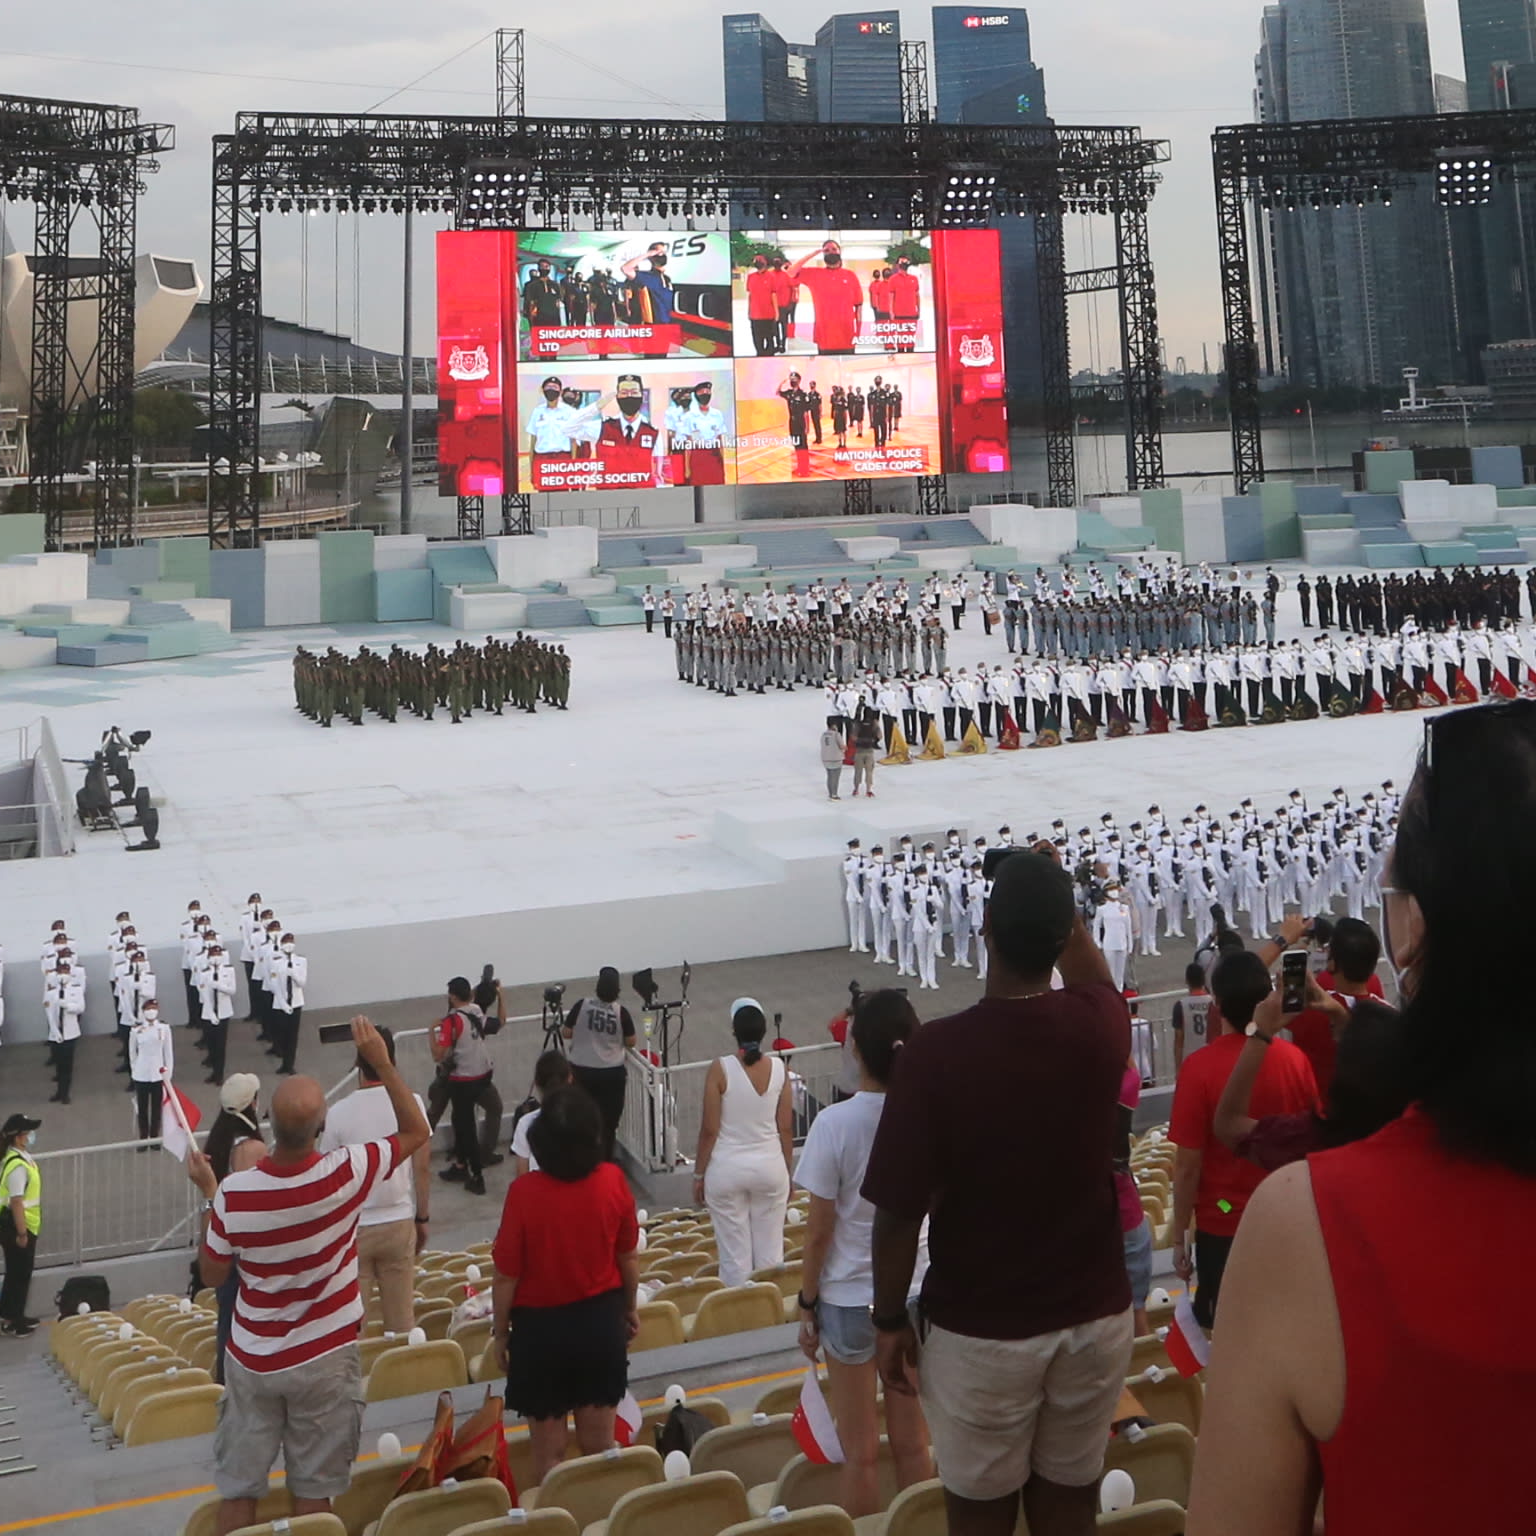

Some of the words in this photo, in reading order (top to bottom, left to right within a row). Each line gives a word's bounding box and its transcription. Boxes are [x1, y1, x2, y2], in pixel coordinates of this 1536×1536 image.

[981, 15, 1009, 26] HSBC
[539, 328, 603, 340] SINGAPORE
[604, 327, 653, 339] AIRLINES
[870, 322, 917, 333] PEOPLE'S
[851, 334, 917, 345] ASSOCIATION
[539, 342, 561, 352] LTD
[834, 450, 885, 461] NATIONAL
[886, 448, 922, 459] POLICE
[540, 461, 605, 474] SINGAPORE
[854, 462, 887, 472] CADET
[889, 460, 923, 470] CORPS
[541, 475, 564, 487] RED
[566, 474, 603, 486] CROSS
[605, 472, 651, 484] SOCIETY
[586, 1009, 617, 1035] 155
